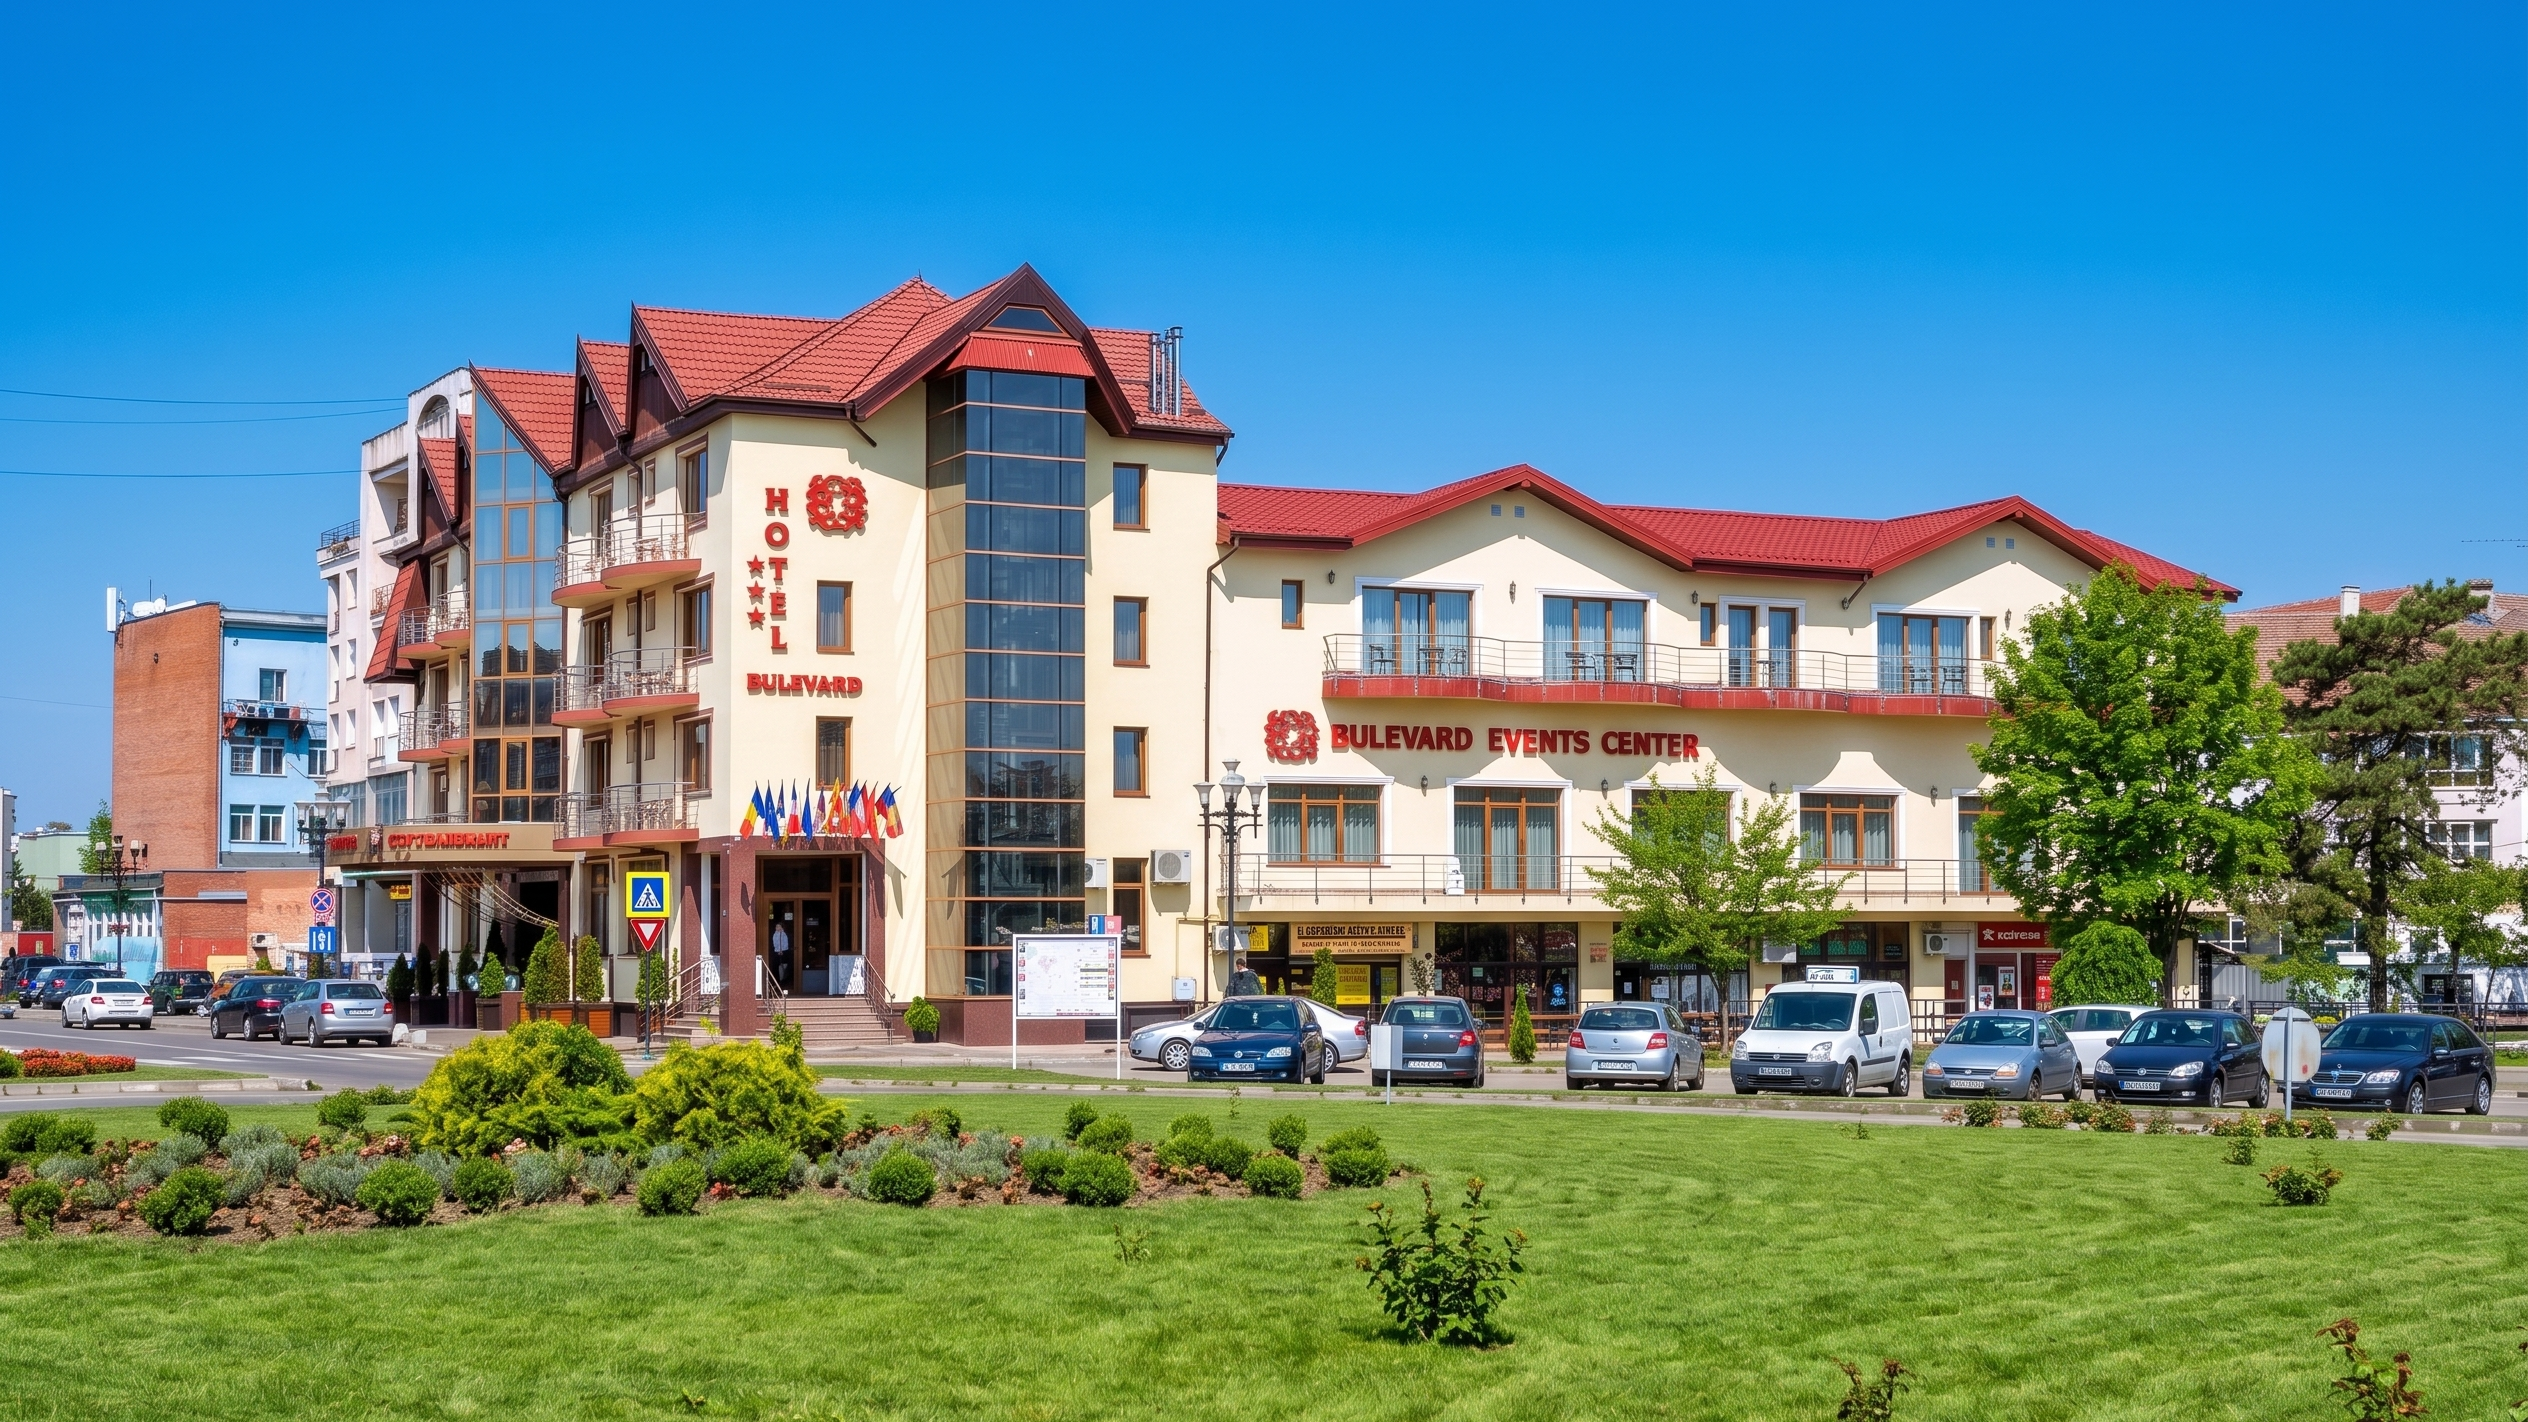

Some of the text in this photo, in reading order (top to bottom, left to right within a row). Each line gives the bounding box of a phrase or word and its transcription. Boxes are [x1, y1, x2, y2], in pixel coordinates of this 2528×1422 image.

[765, 487, 790, 650] HOTEL
[747, 673, 863, 695] BULEVARD
[1331, 723, 1700, 759] BULEVARD EVENTS CENTER
